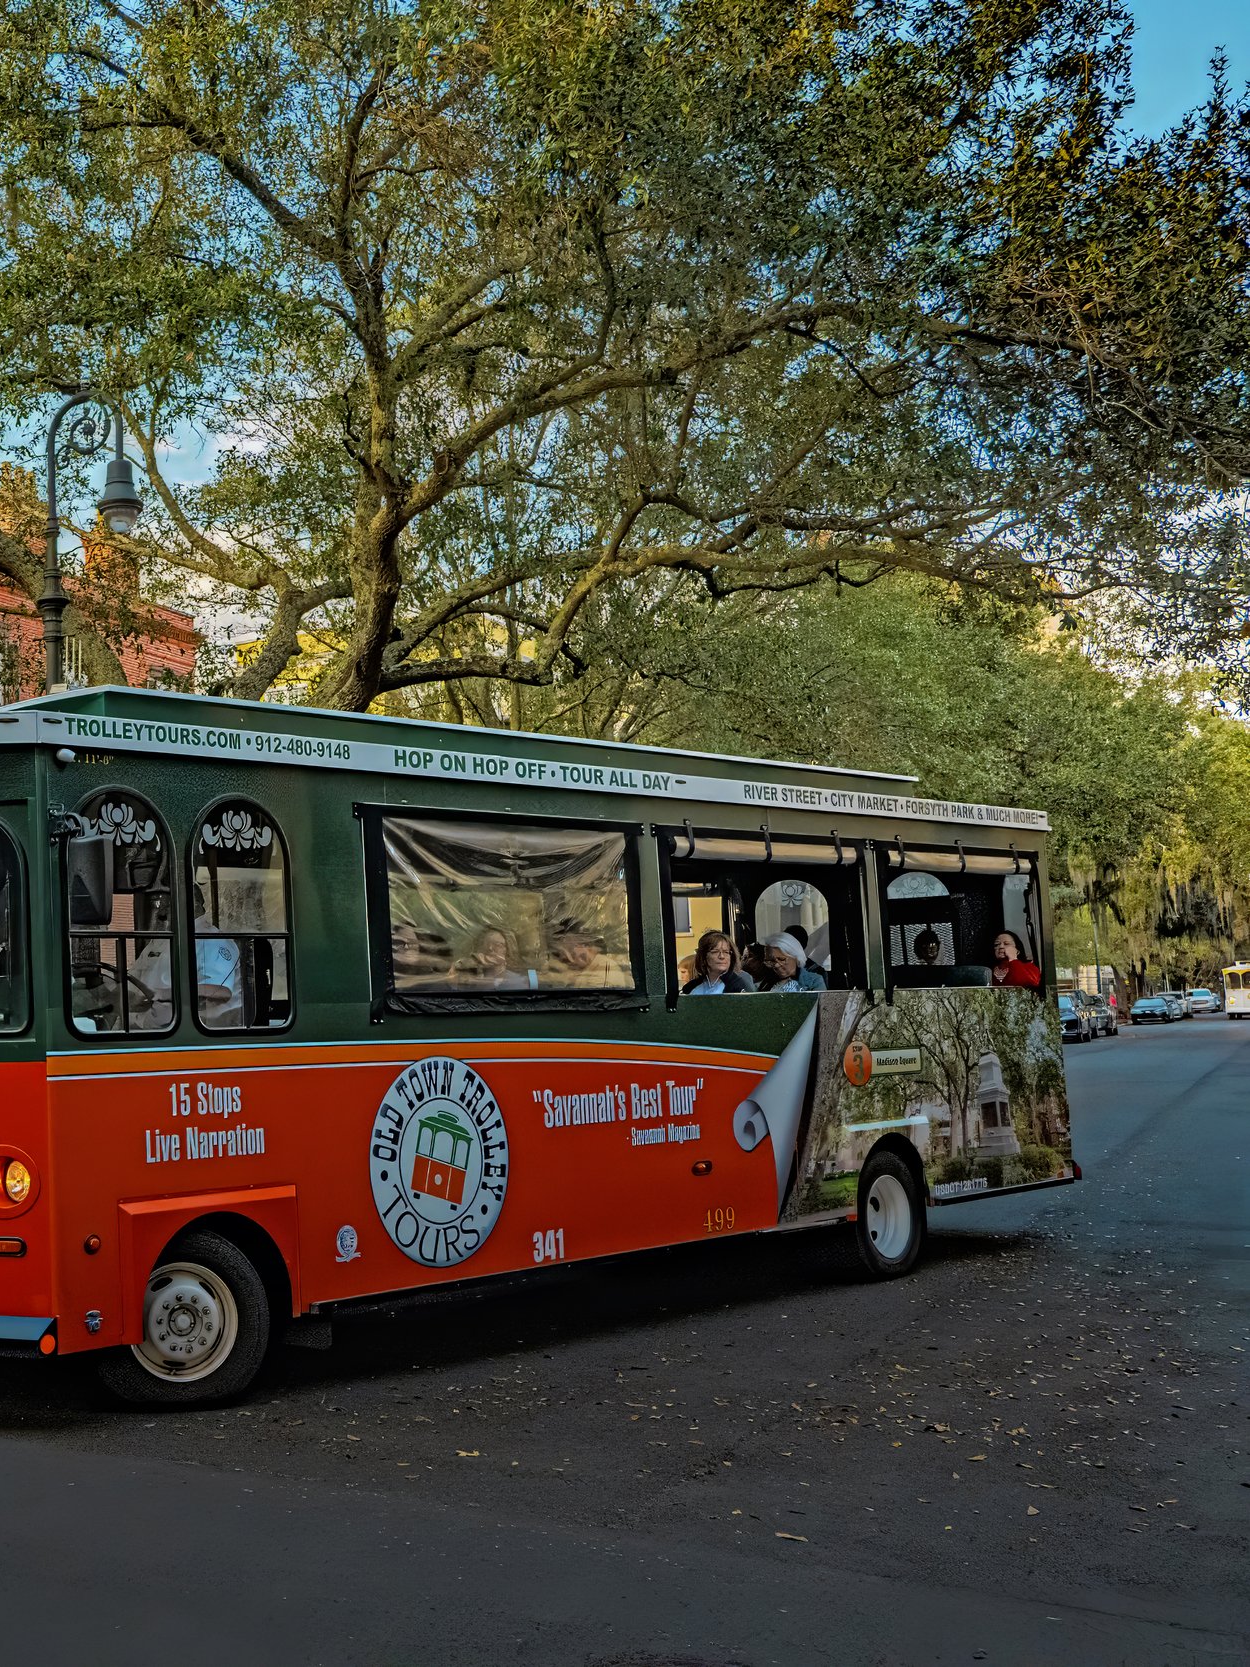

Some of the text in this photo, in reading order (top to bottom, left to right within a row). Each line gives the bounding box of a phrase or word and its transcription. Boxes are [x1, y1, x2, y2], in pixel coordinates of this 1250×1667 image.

[64, 717, 351, 760] TROLLEYTOURS.COM 912-480-9148
[394, 749, 671, 791] HOP ON HOP OFF TOUR ALL DAY
[744, 784, 778, 801] RIVER
[781, 788, 822, 805] STREET
[831, 792, 855, 808] CITY
[857, 795, 899, 812] MARKET
[906, 800, 949, 817] FORSYTH
[951, 805, 975, 820] PARK
[977, 808, 984, 820] &
[986, 808, 1011, 823] MUCH
[853, 1054, 865, 1081] 3
[169, 1081, 242, 1119] 15 Stops
[532, 1078, 704, 1128] "Savannah's Best Tour"
[145, 1123, 265, 1163] Live Narration
[372, 1060, 507, 1202] OLD TOWN TROLLEY
[631, 1121, 701, 1147] Savannah Magazine
[382, 1184, 480, 1263] TOURS
[703, 1206, 735, 1233] 499
[532, 1228, 565, 1263] 341
